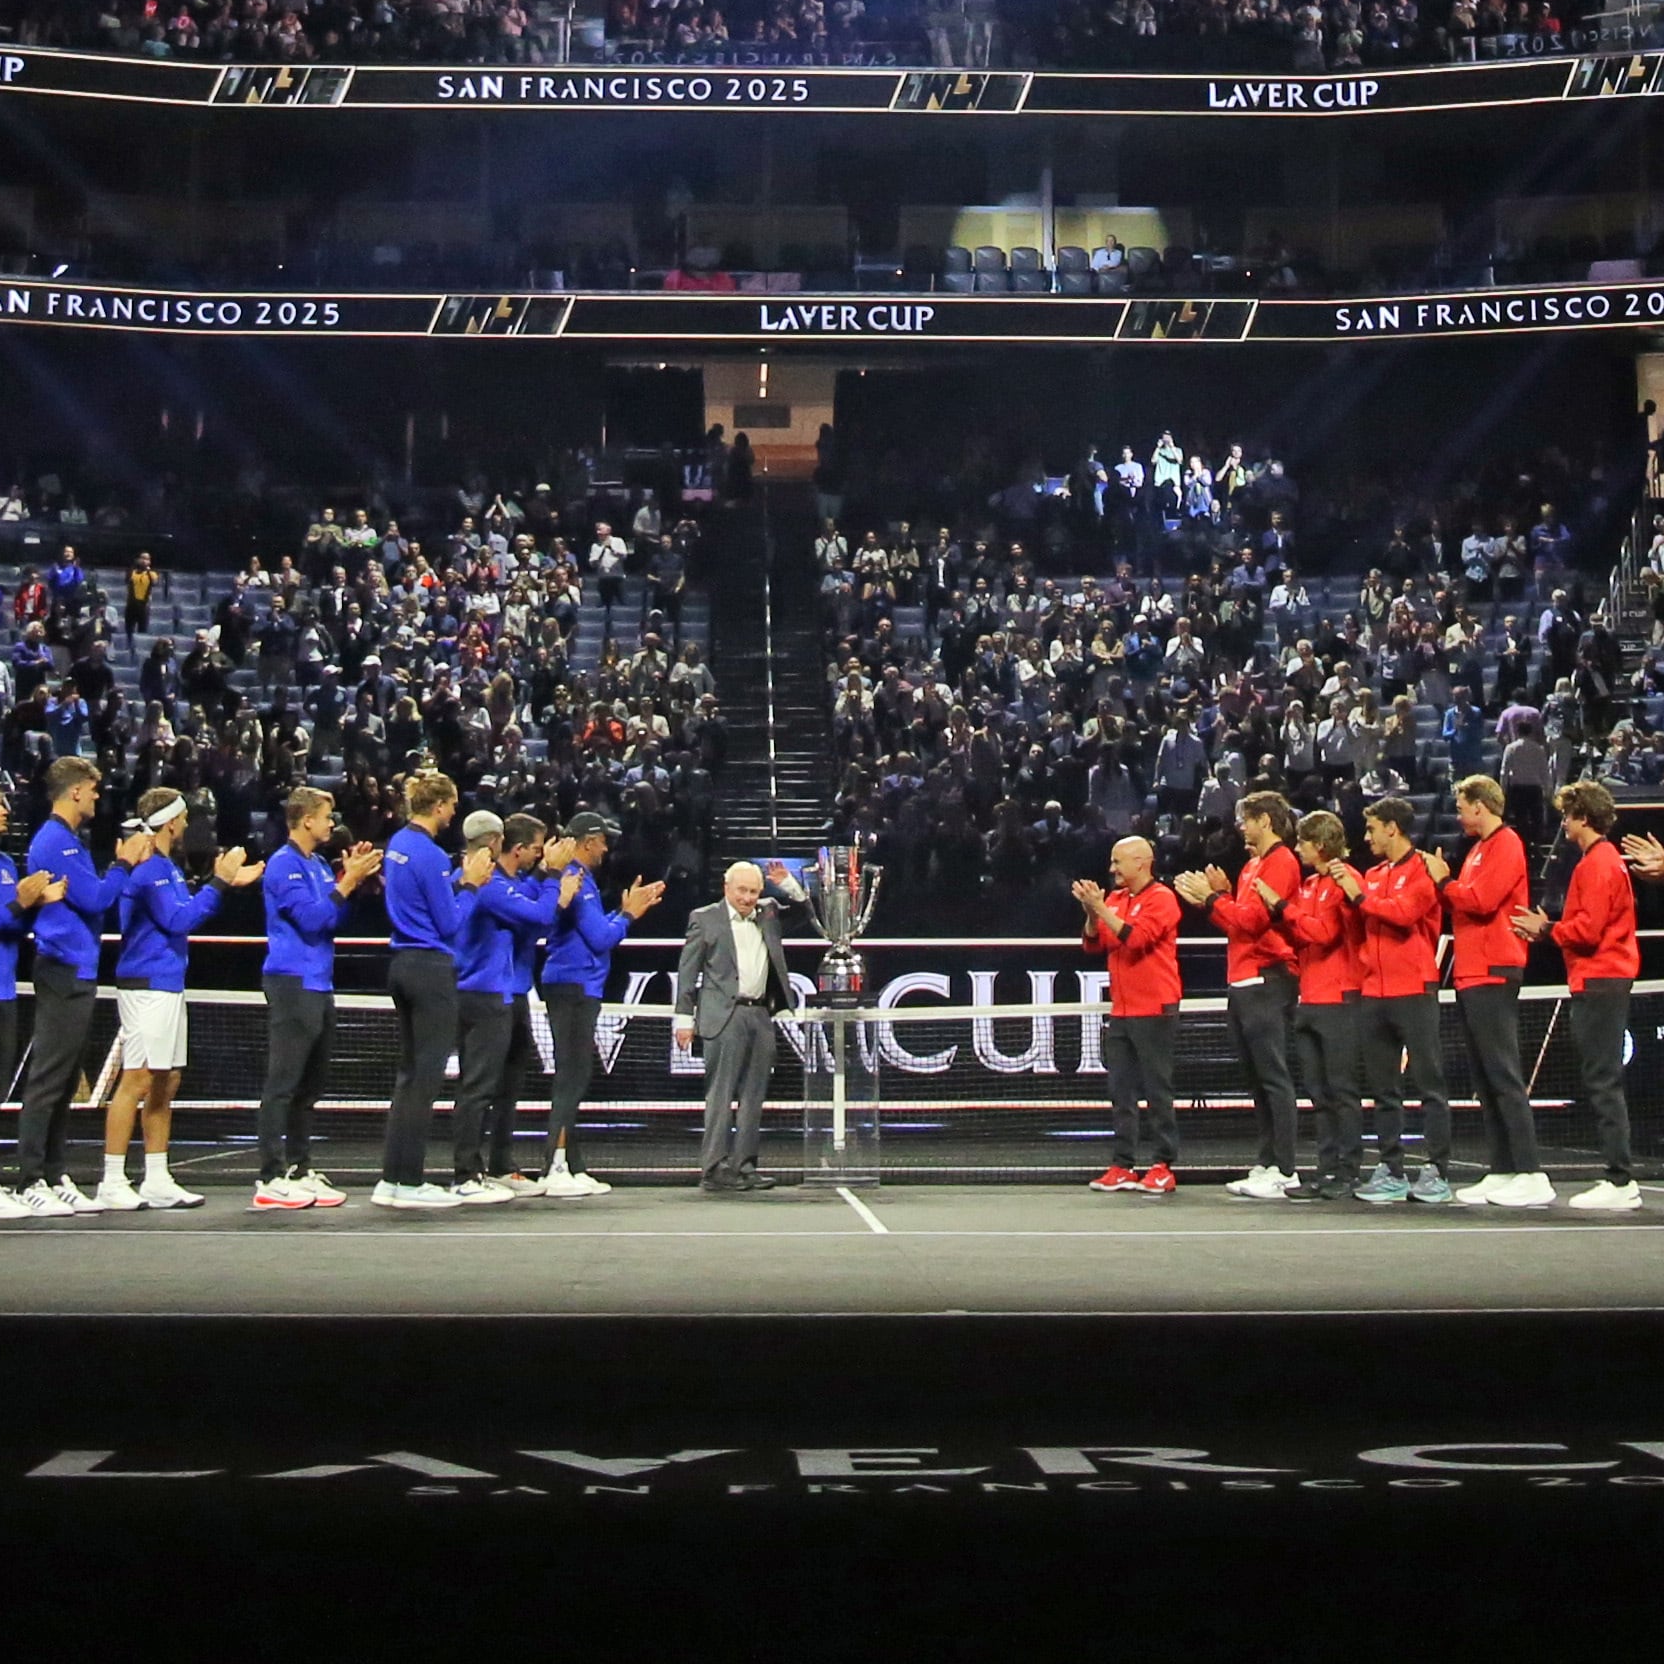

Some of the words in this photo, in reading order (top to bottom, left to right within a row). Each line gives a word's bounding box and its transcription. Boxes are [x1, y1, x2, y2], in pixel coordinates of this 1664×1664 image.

[437, 74, 504, 99] SAN
[519, 76, 712, 101] FRANCISCO
[725, 78, 809, 102] 2025
[1208, 82, 1308, 109] LAVER
[1312, 80, 1379, 108] CUP
[46, 292, 242, 325] FRANCISCO
[255, 301, 340, 326] 2025
[760, 304, 862, 331] LAVER
[867, 305, 935, 331] CUP
[1335, 305, 1400, 331] SAN
[1417, 295, 1610, 327] FRANCISCO
[24, 1447, 1304, 1479] LAVER
